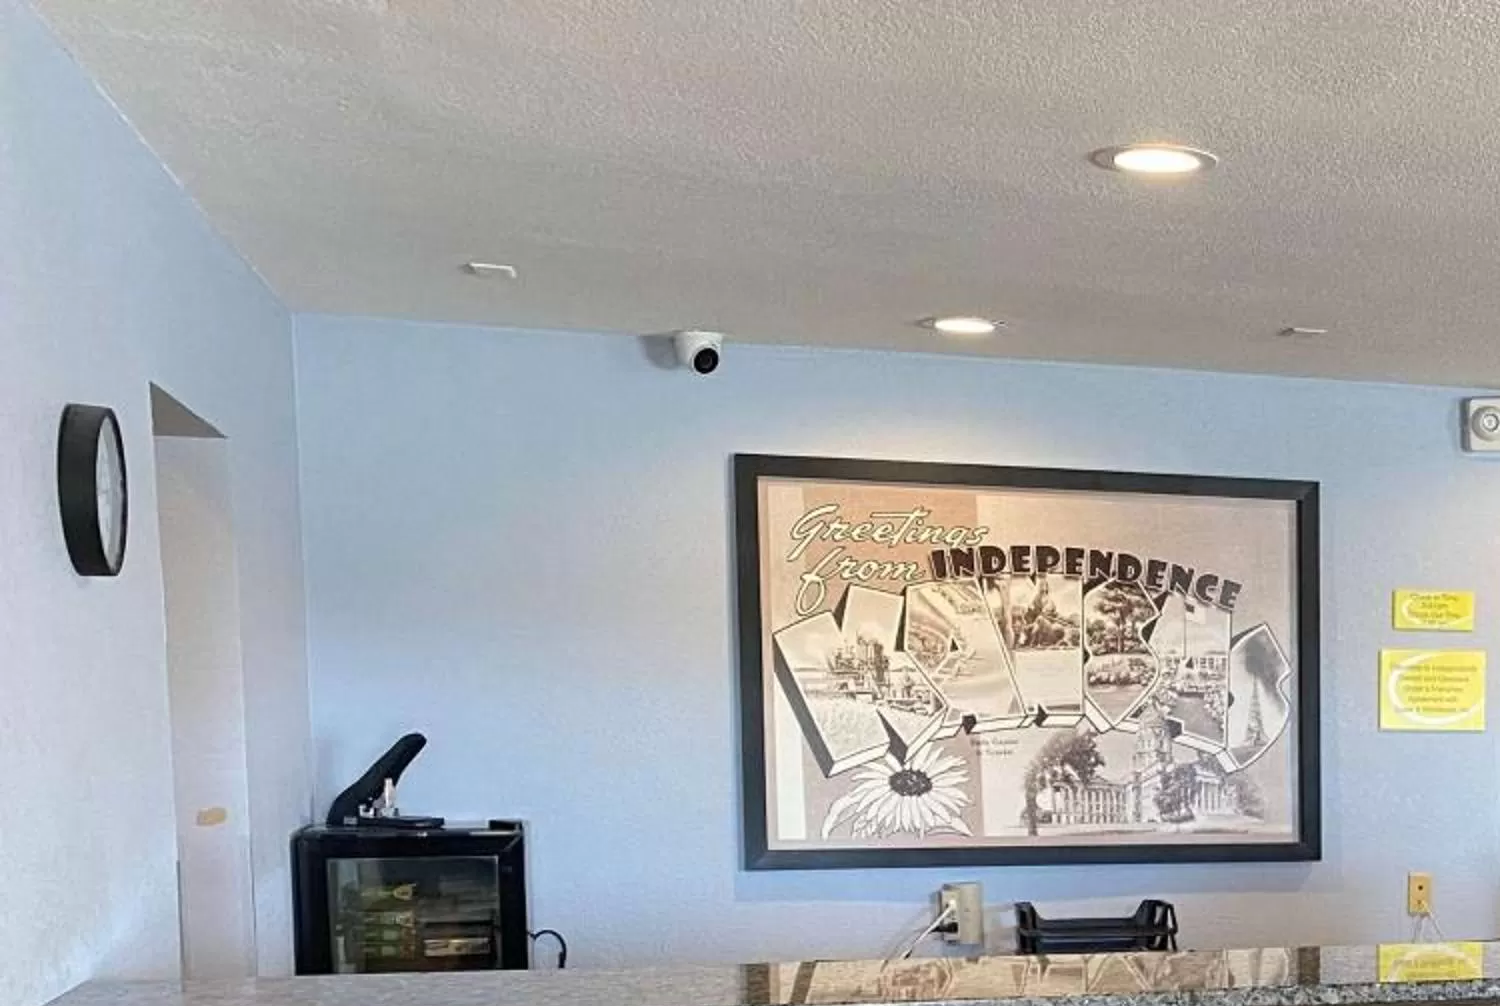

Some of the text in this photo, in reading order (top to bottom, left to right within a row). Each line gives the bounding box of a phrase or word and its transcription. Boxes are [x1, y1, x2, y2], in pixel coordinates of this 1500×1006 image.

[786, 503, 990, 562] Greetings
[796, 545, 1243, 616] from INDEPENDENCE
